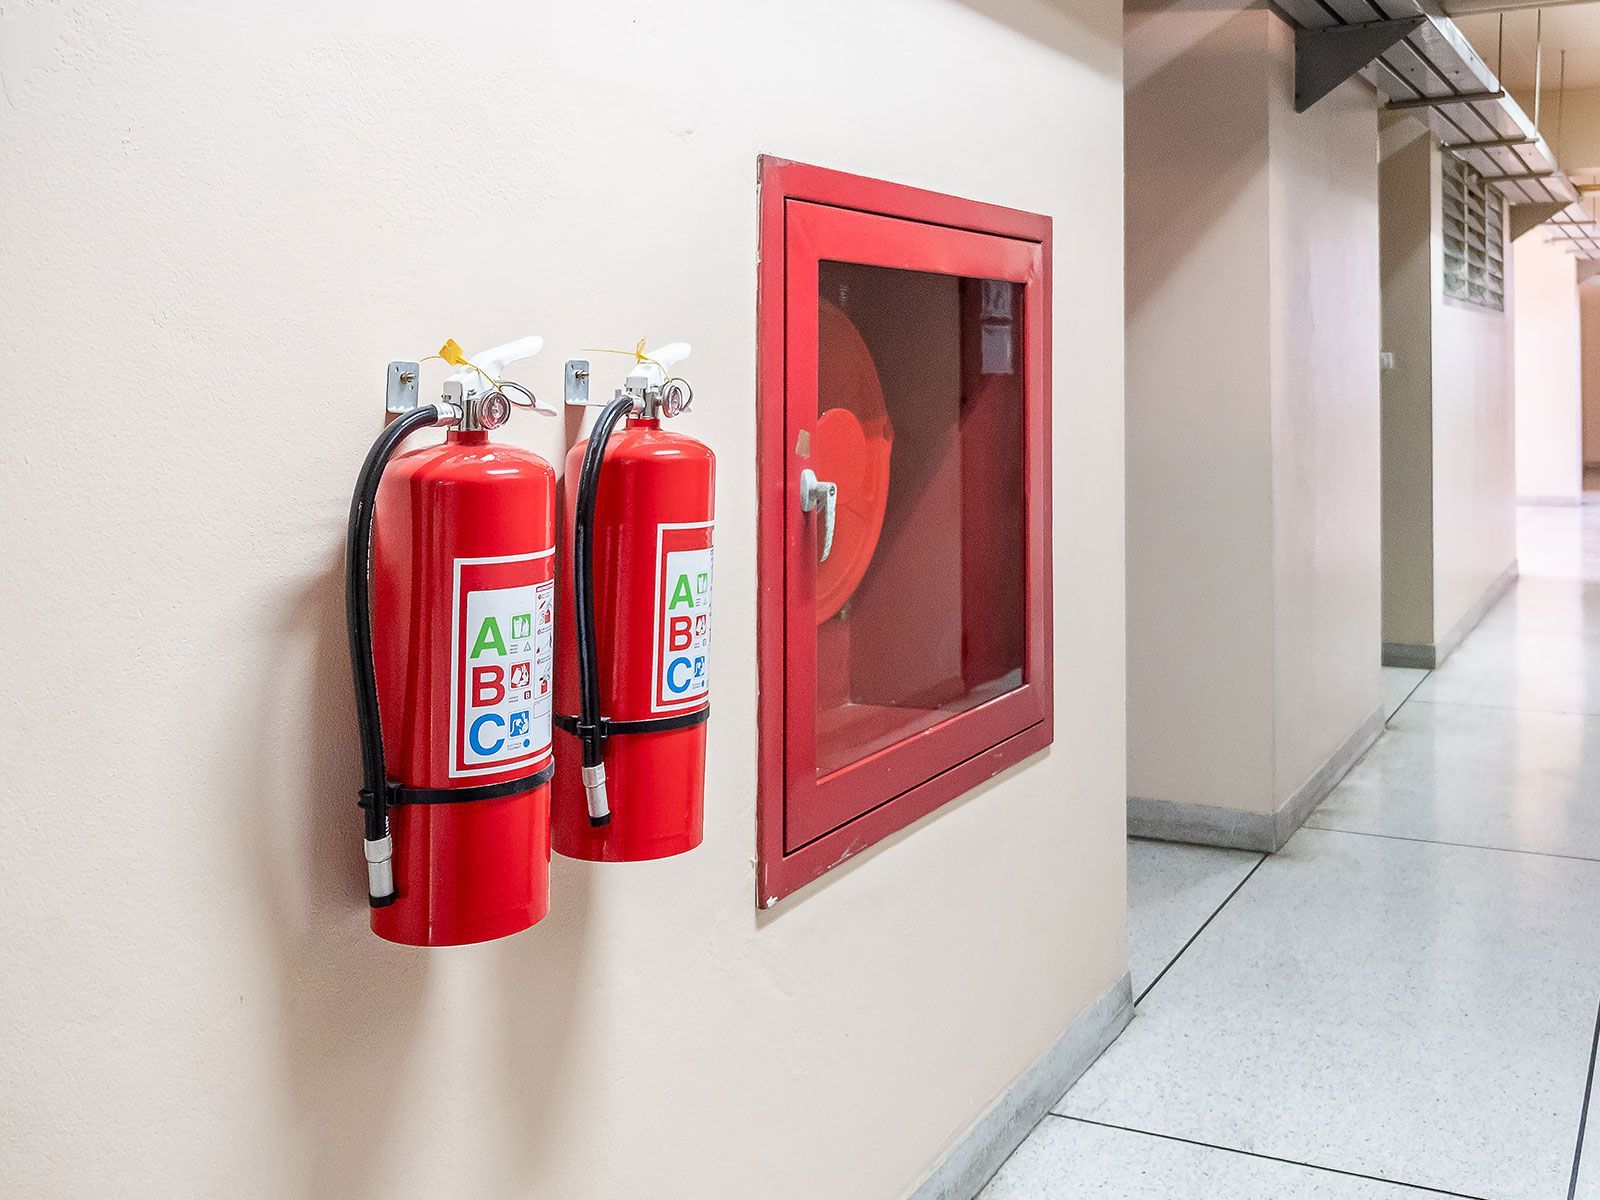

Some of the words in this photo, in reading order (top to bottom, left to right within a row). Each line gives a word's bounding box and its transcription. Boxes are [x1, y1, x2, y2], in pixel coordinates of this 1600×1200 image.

[668, 574, 694, 610] A
[470, 616, 507, 659] A
[669, 615, 693, 652] B
[471, 664, 506, 708] B
[666, 656, 692, 693] C
[469, 713, 506, 756] C
